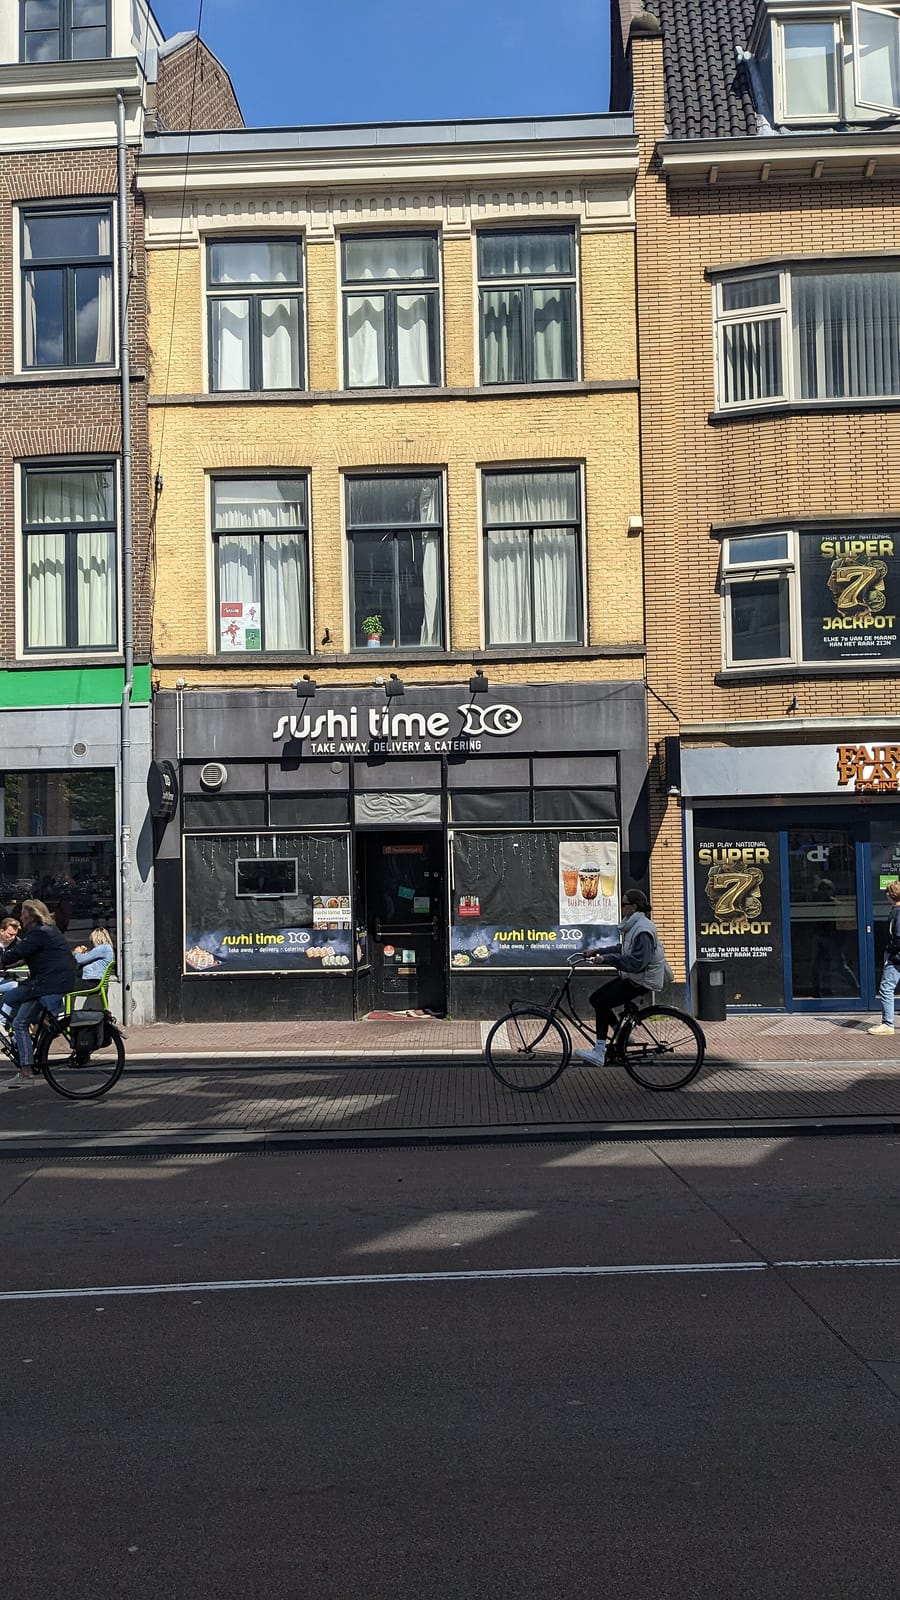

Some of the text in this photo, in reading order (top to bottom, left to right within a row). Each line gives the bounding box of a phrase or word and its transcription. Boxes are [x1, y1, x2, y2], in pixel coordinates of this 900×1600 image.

[820, 539, 895, 558] SUPER
[836, 565, 877, 609] 7
[822, 615, 896, 630] JACKPOT
[272, 705, 450, 739] sushi time
[310, 742, 336, 754] TAKE
[373, 740, 421, 753] DELIVERY
[423, 740, 432, 751] &
[434, 739, 482, 751] CATERING
[836, 745, 900, 765] FAIR
[837, 763, 900, 786] PLAY
[698, 847, 770, 865] SUPER
[713, 872, 753, 915] 7
[493, 929, 557, 941] sushi time
[700, 921, 772, 935] JACKPOT
[221, 932, 285, 946] sushi time
